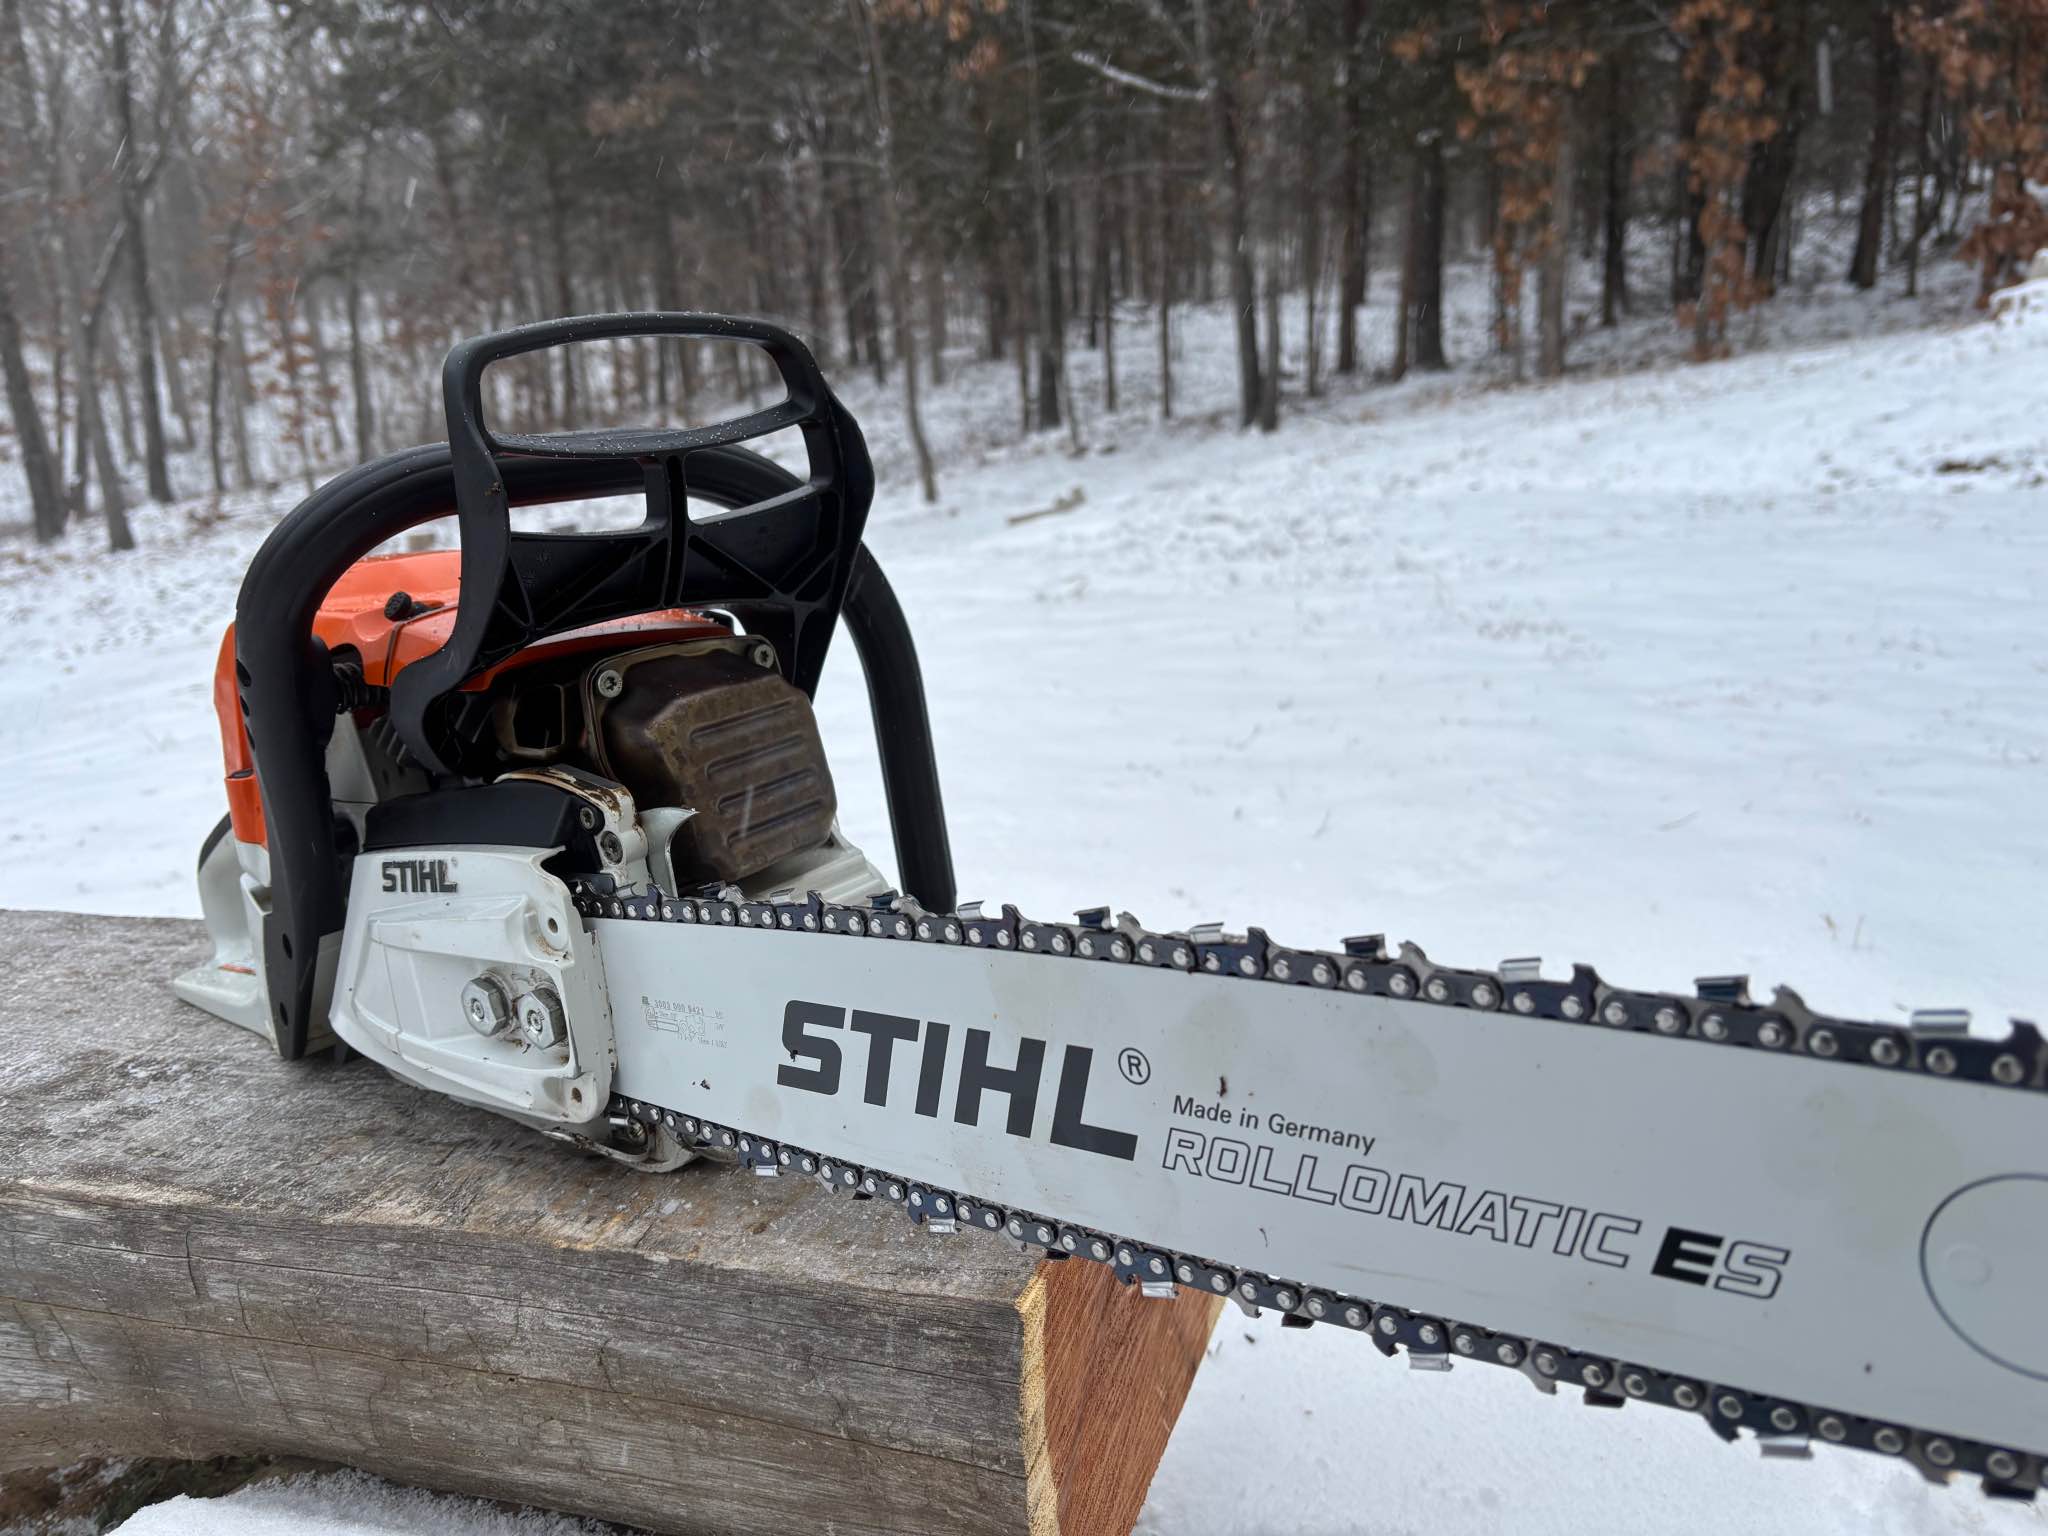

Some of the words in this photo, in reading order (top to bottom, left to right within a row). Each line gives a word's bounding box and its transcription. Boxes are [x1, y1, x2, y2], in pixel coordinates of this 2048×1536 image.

[382, 859, 458, 893] STIHL
[777, 1000, 1138, 1161] STIHL
[1173, 1095, 1232, 1124] Made
[1239, 1107, 1259, 1129] in
[1268, 1113, 1375, 1156] Germany
[1162, 1127, 1642, 1268] ROLLOMATIC
[1651, 1226, 1791, 1300] ES
